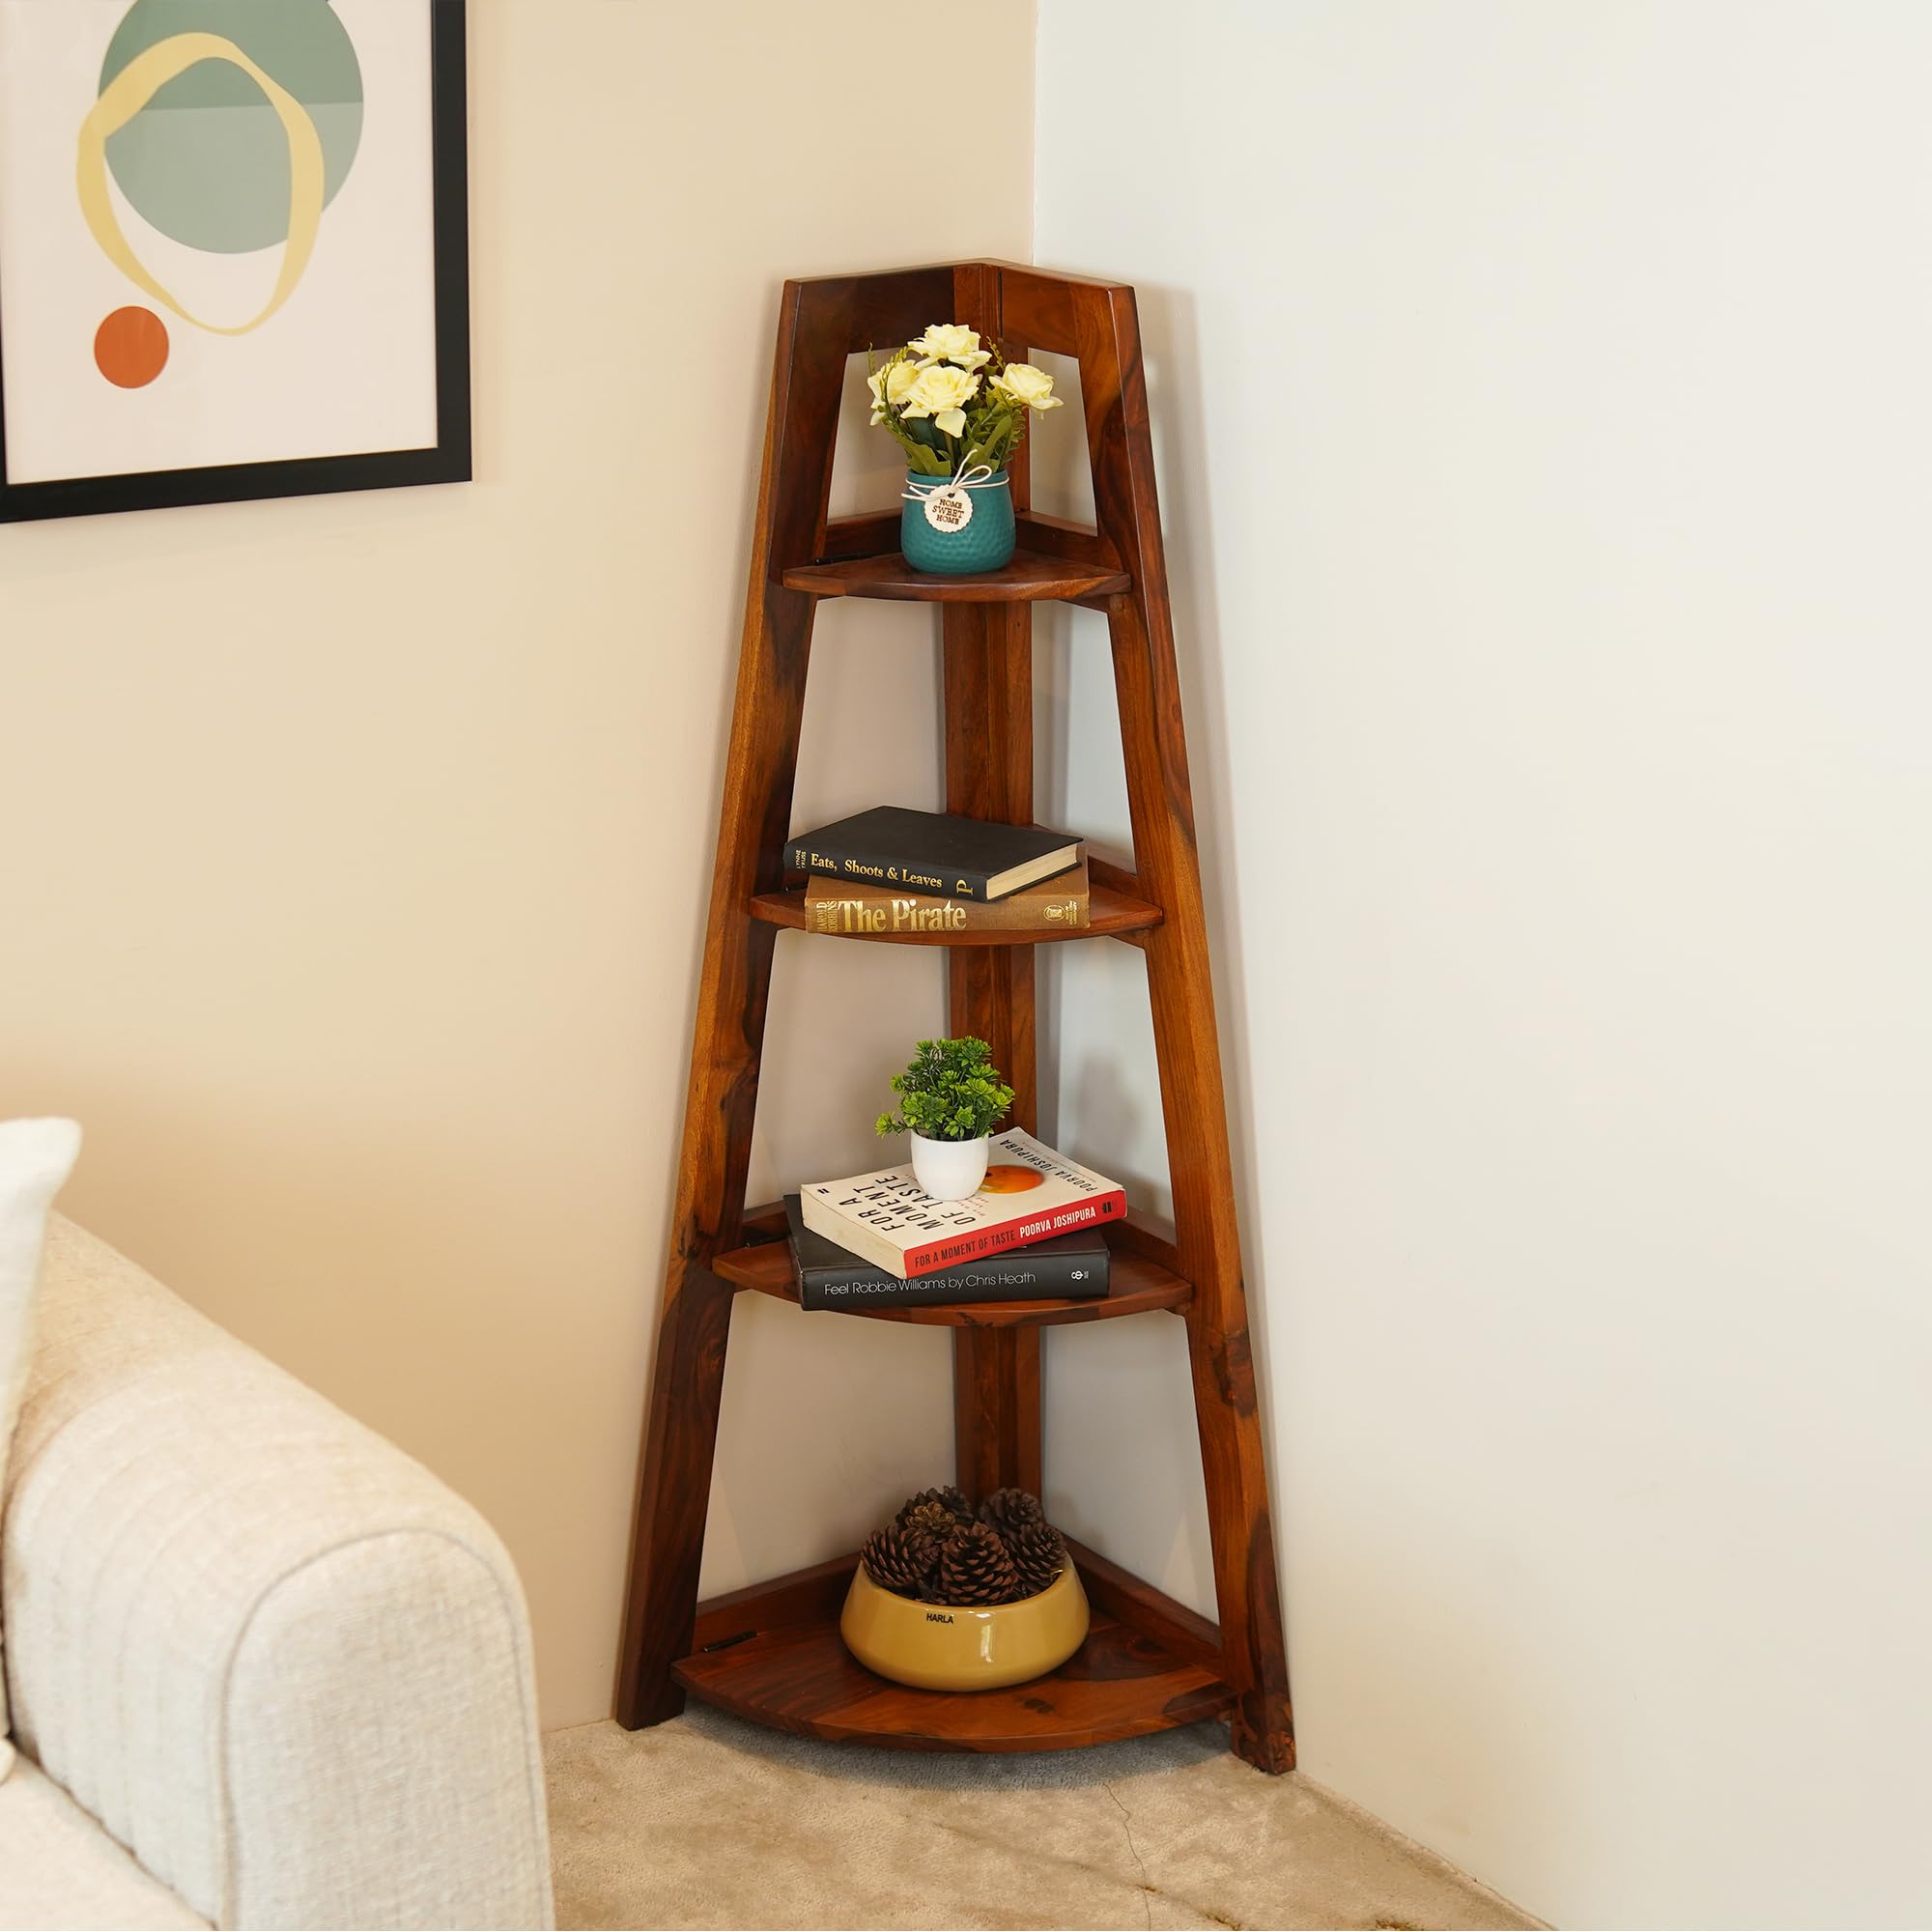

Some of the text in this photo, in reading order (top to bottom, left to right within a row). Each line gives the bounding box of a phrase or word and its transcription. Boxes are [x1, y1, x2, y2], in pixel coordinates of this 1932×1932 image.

[932, 505, 964, 518] SWEET
[939, 499, 962, 509] HOME
[936, 515, 959, 525] HOME
[810, 853, 943, 888] Eats, Shoots & Leaves
[815, 901, 828, 932] HAROLD
[838, 898, 967, 933] The Pirate
[999, 1139, 1058, 1172] JOSHIPURA
[875, 1175, 944, 1209] TASTE
[1055, 1170, 1098, 1192] POORVA
[838, 1197, 905, 1232] FOR A
[853, 1185, 946, 1231] MOMENT
[940, 1211, 977, 1225] OF
[1019, 1206, 1096, 1238] POORVA JOSHIPURA
[915, 1229, 1015, 1267] FOR A MOMENT OF TASTE
[824, 1271, 1037, 1295] Feel Robbie Williams by Chris Heath
[926, 1613, 953, 1624] HARLA
